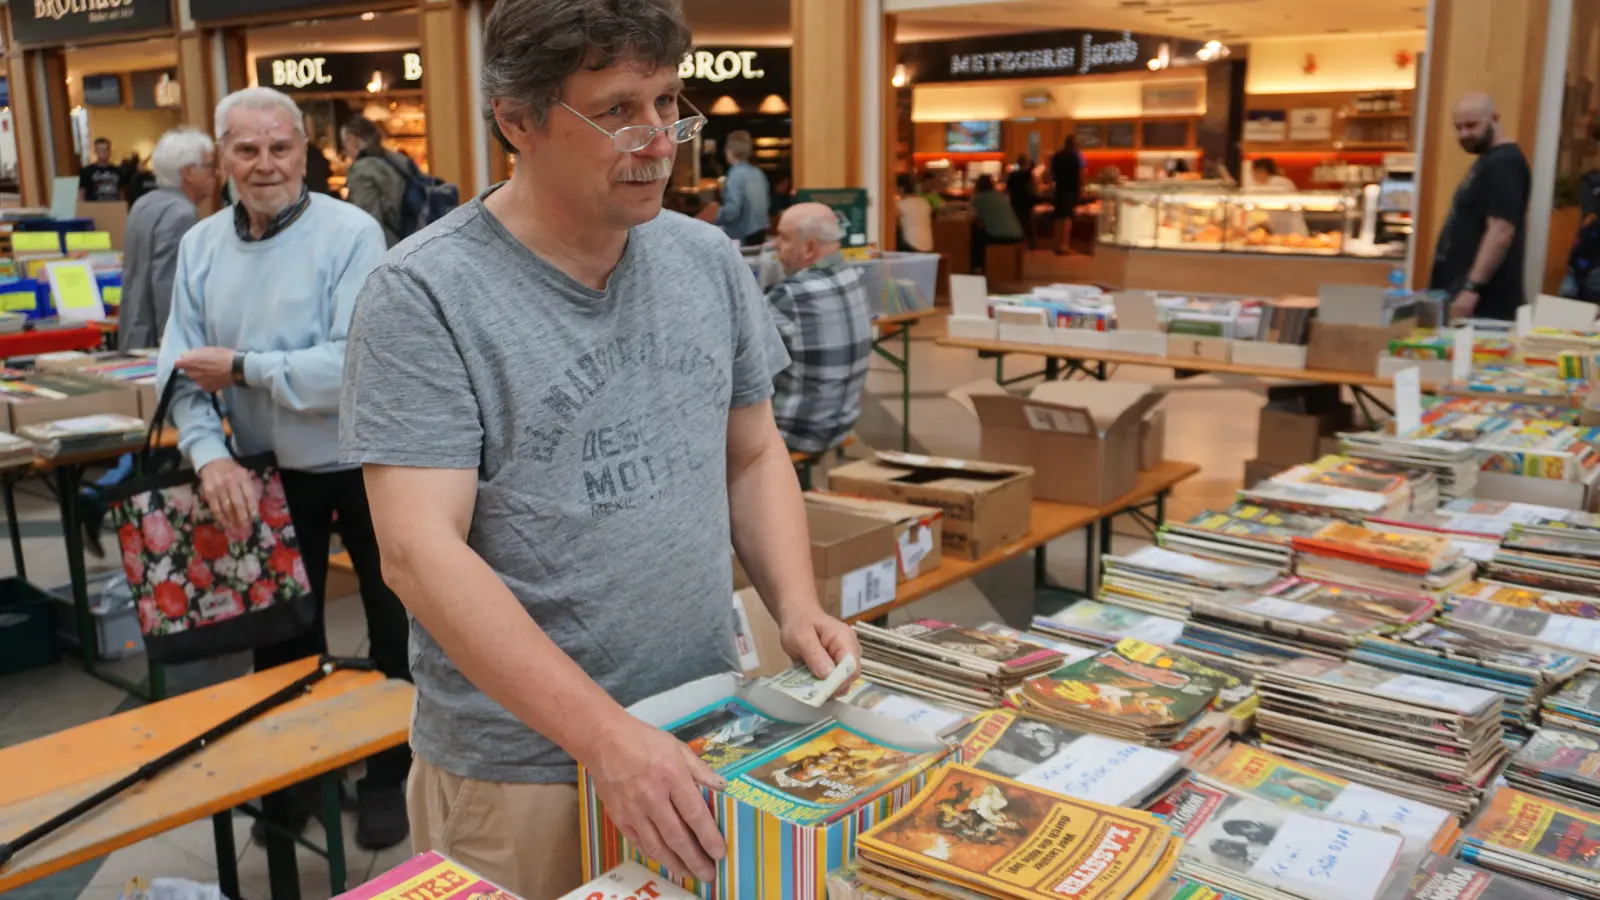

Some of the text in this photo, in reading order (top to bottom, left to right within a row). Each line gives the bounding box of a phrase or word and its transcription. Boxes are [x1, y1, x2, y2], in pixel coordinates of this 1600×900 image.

[950, 47, 1076, 75] METZGEREI
[1050, 815, 1071, 837] durch
[1032, 833, 1077, 871] Wer Lassiter
[1054, 826, 1130, 895] LASSITER
